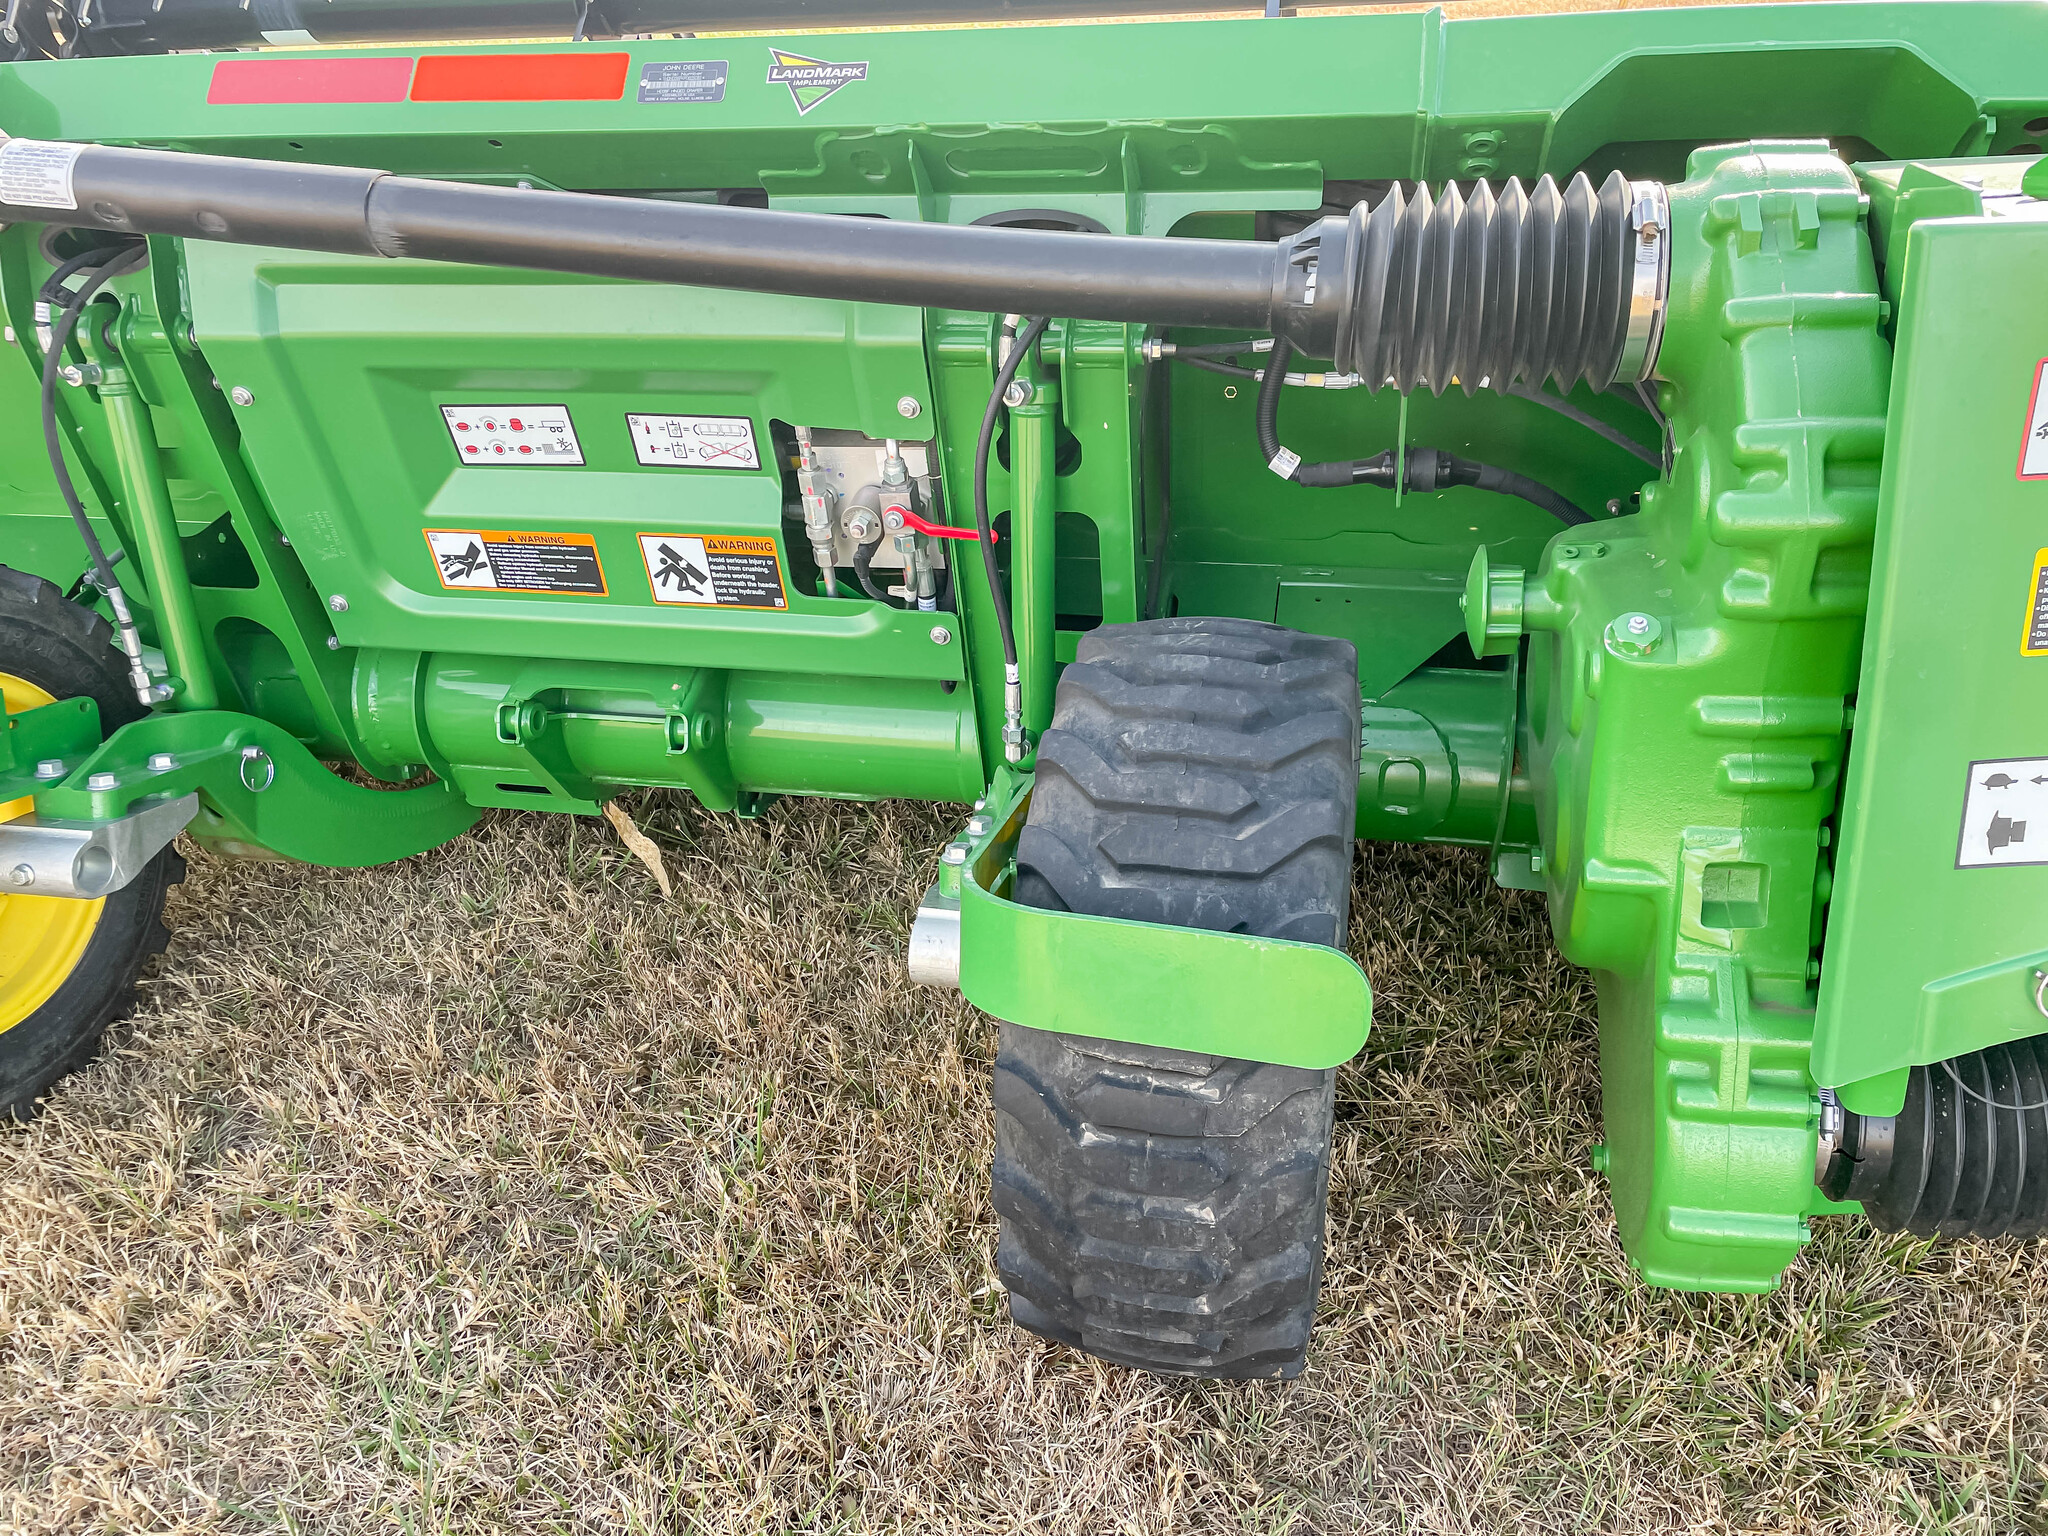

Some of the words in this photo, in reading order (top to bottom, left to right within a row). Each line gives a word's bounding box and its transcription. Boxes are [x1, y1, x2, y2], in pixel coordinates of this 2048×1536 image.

[771, 67, 864, 79] LANDMARK
[518, 535, 565, 544] WARNING
[718, 540, 773, 551] WARNING
[749, 558, 766, 566] injury
[732, 573, 756, 581] working
[739, 588, 766, 596] hydraulic
